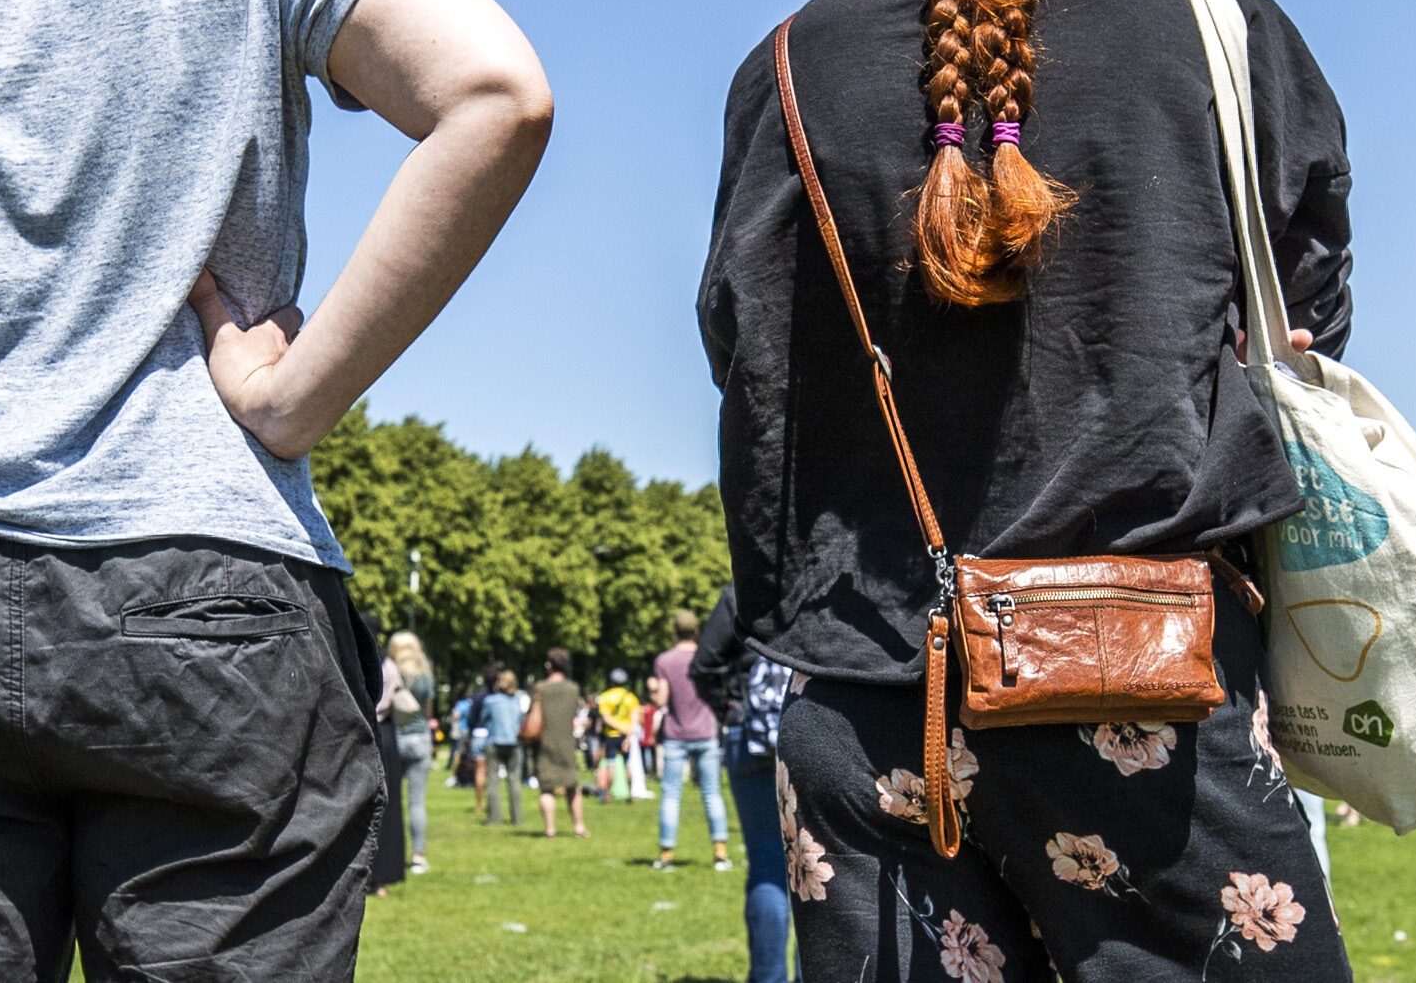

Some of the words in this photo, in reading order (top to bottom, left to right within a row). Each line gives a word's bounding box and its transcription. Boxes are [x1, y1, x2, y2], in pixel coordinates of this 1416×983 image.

[1295, 465, 1324, 490] et
[1298, 498, 1355, 524] ste
[1296, 704, 1317, 720] tas
[1296, 724, 1319, 738] van
[1315, 739, 1361, 757] katoen.
